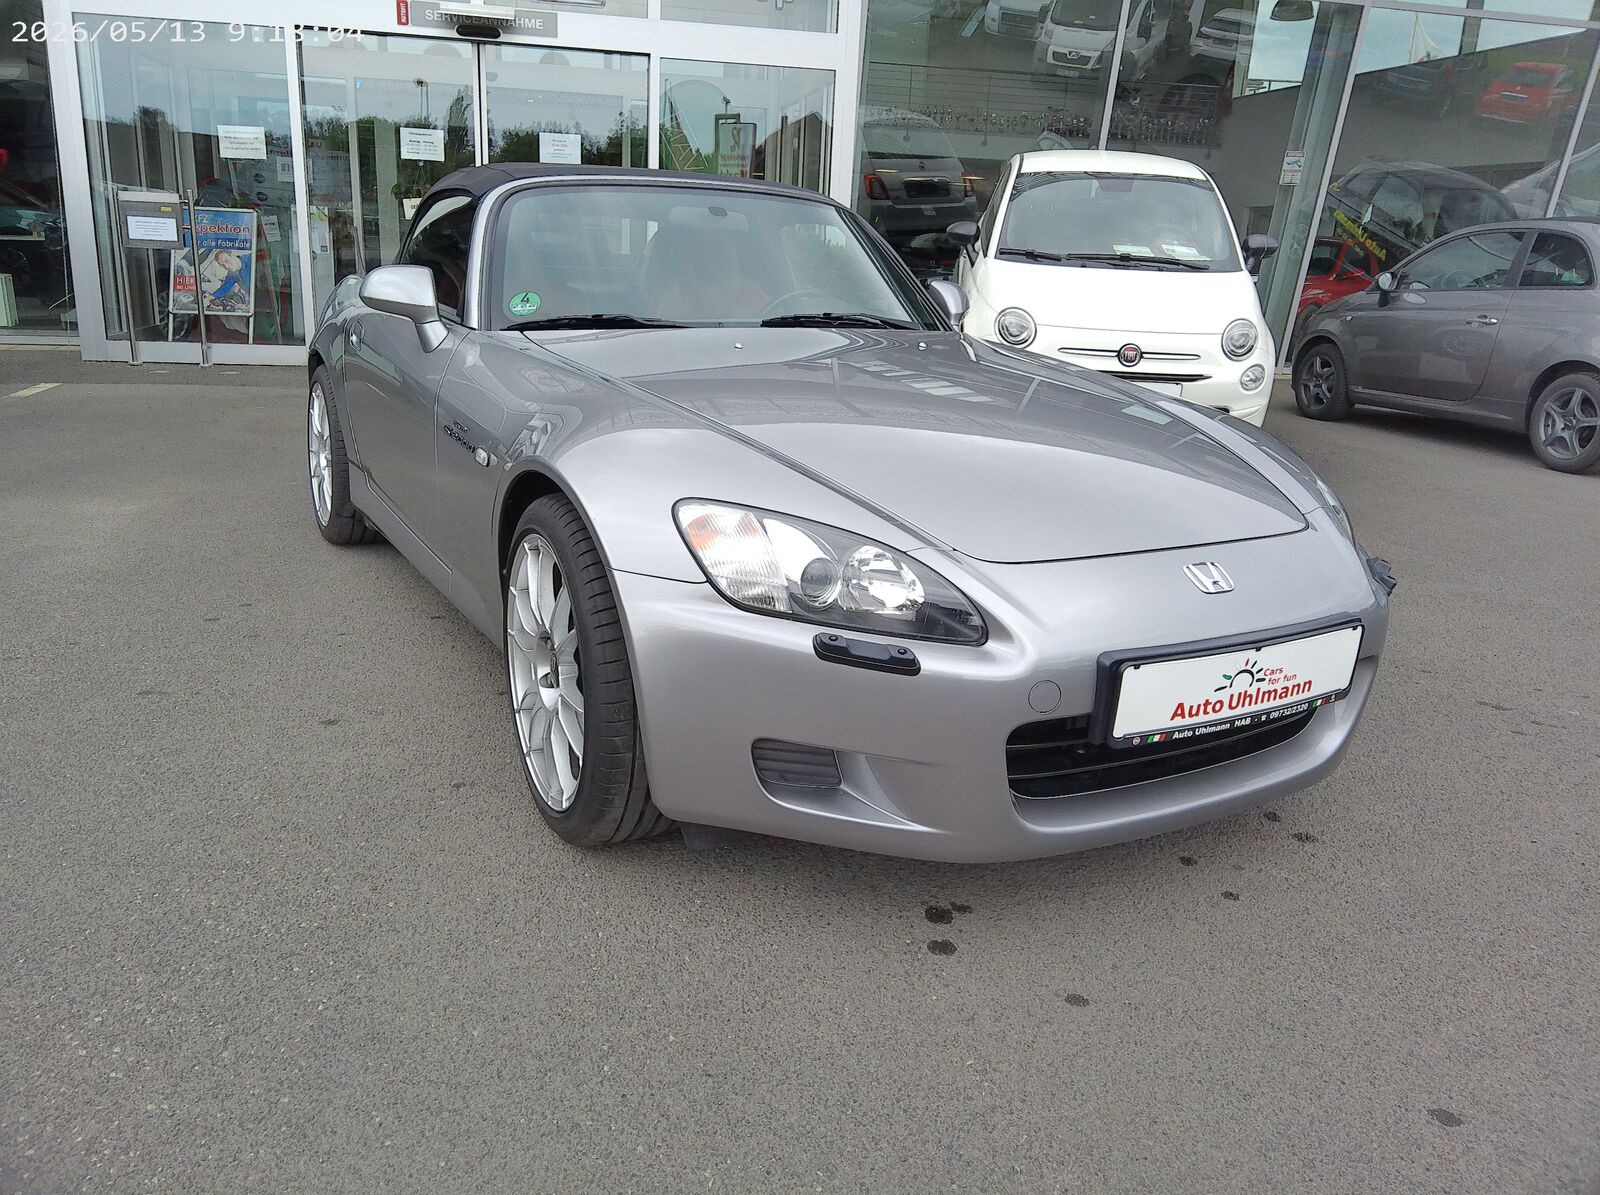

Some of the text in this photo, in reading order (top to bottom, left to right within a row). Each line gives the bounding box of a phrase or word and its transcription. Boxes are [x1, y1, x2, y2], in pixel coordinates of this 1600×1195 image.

[425, 9, 544, 30] SERVICEANNAHME
[217, 239, 251, 248] Fabrikate
[520, 292, 530, 304] 4
[1263, 666, 1284, 677] Cars
[1268, 673, 1297, 687] for fun
[1170, 680, 1313, 721] Auto Uhlmann
[1172, 730, 1193, 740] Auto
[1195, 723, 1231, 736] Uhlmann
[1234, 717, 1252, 728] HAB
